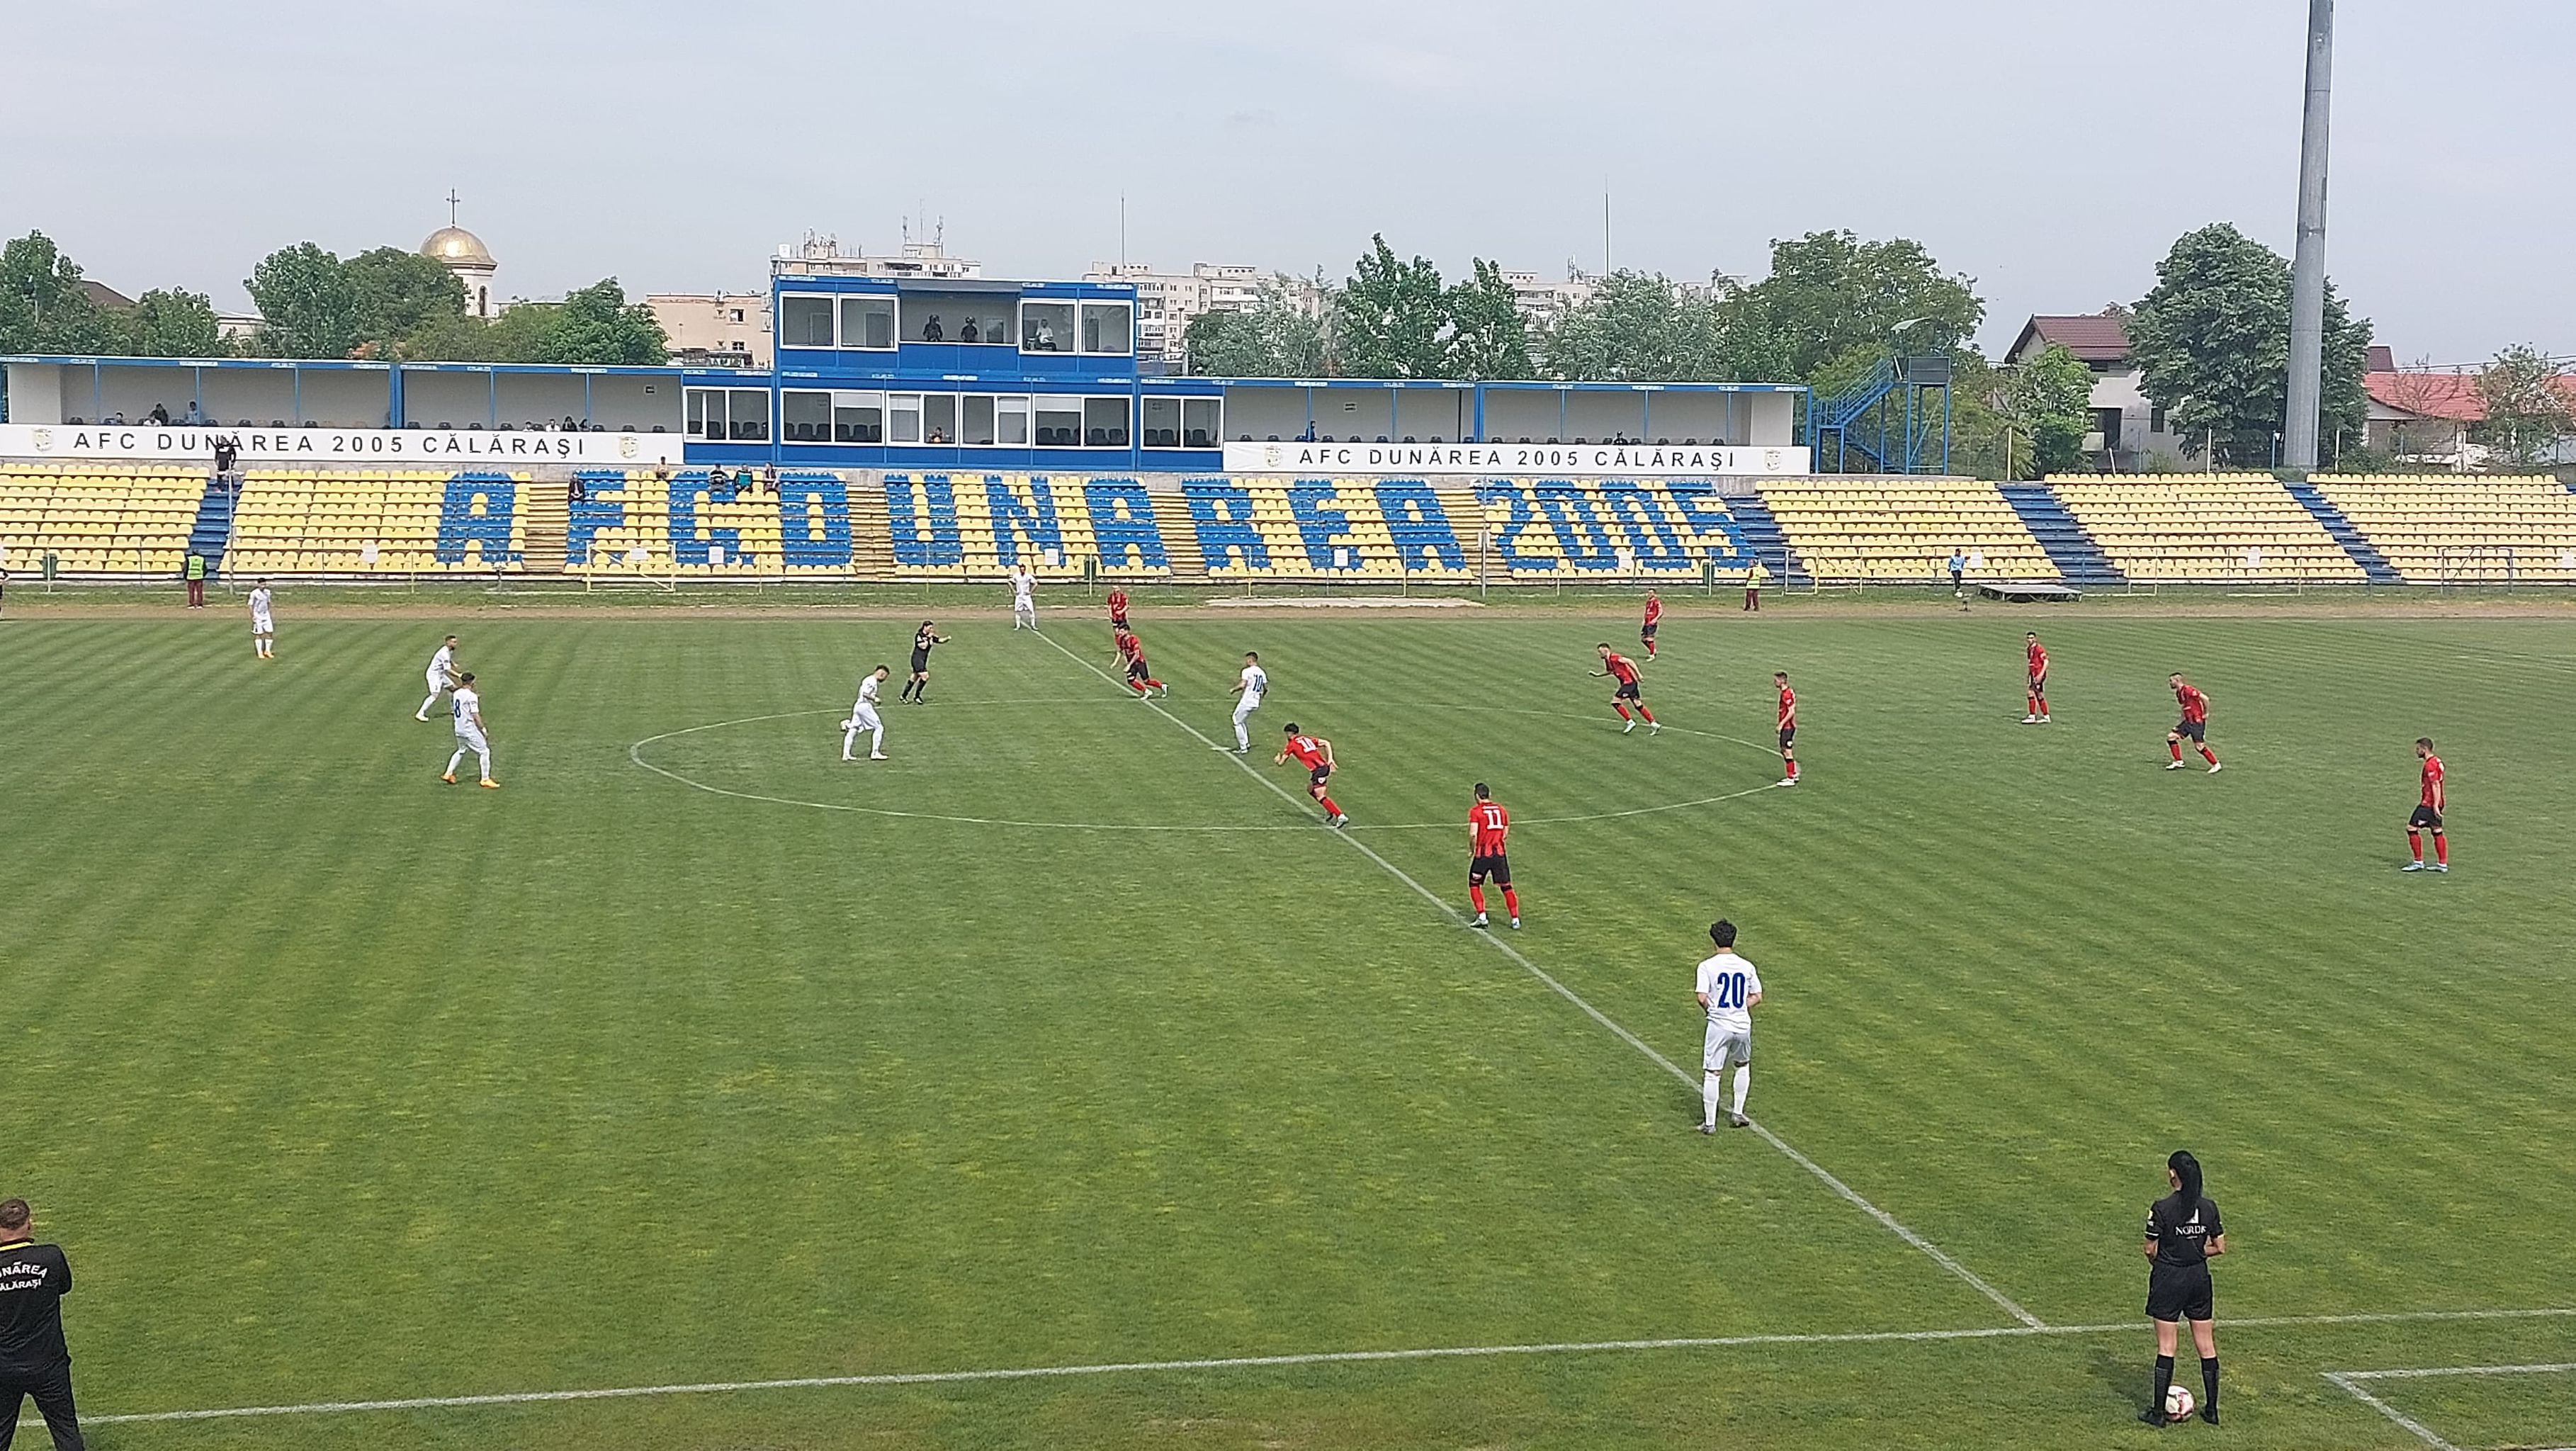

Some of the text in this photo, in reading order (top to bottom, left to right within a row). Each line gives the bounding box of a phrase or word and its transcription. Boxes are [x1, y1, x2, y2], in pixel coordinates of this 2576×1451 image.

[73, 430, 584, 459] AFC DUNĂREA 2005 CĂLĂRAŞI
[1299, 446, 1735, 471] AFC DUNĂREA 2005 CĂLĂRAŞI
[1253, 674, 1264, 692] 10
[1482, 809, 1504, 830] 11
[1717, 971, 1746, 1009] 20
